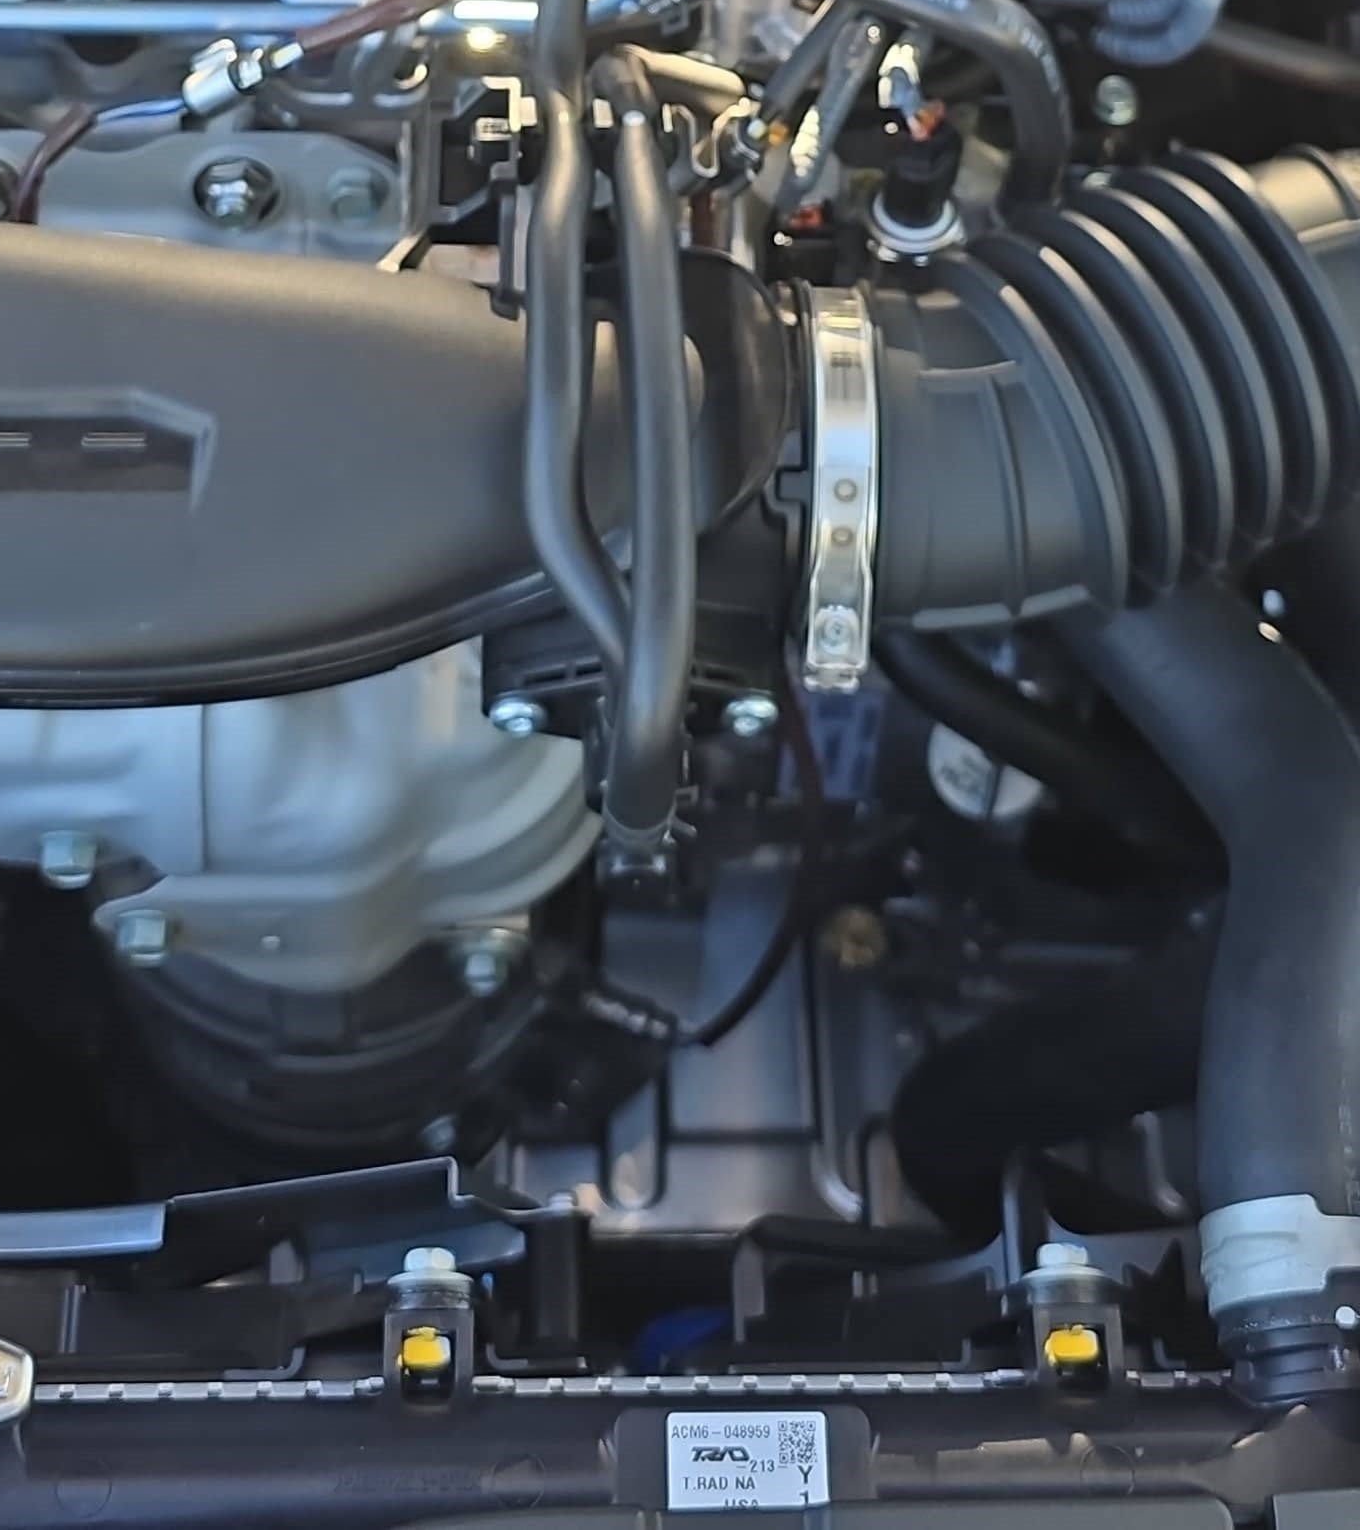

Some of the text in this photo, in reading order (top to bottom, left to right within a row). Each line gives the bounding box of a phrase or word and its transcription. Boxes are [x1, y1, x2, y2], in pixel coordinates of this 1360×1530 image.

[797, 1465, 813, 1484] Y
[683, 1476, 755, 1490] T.RAD NA
